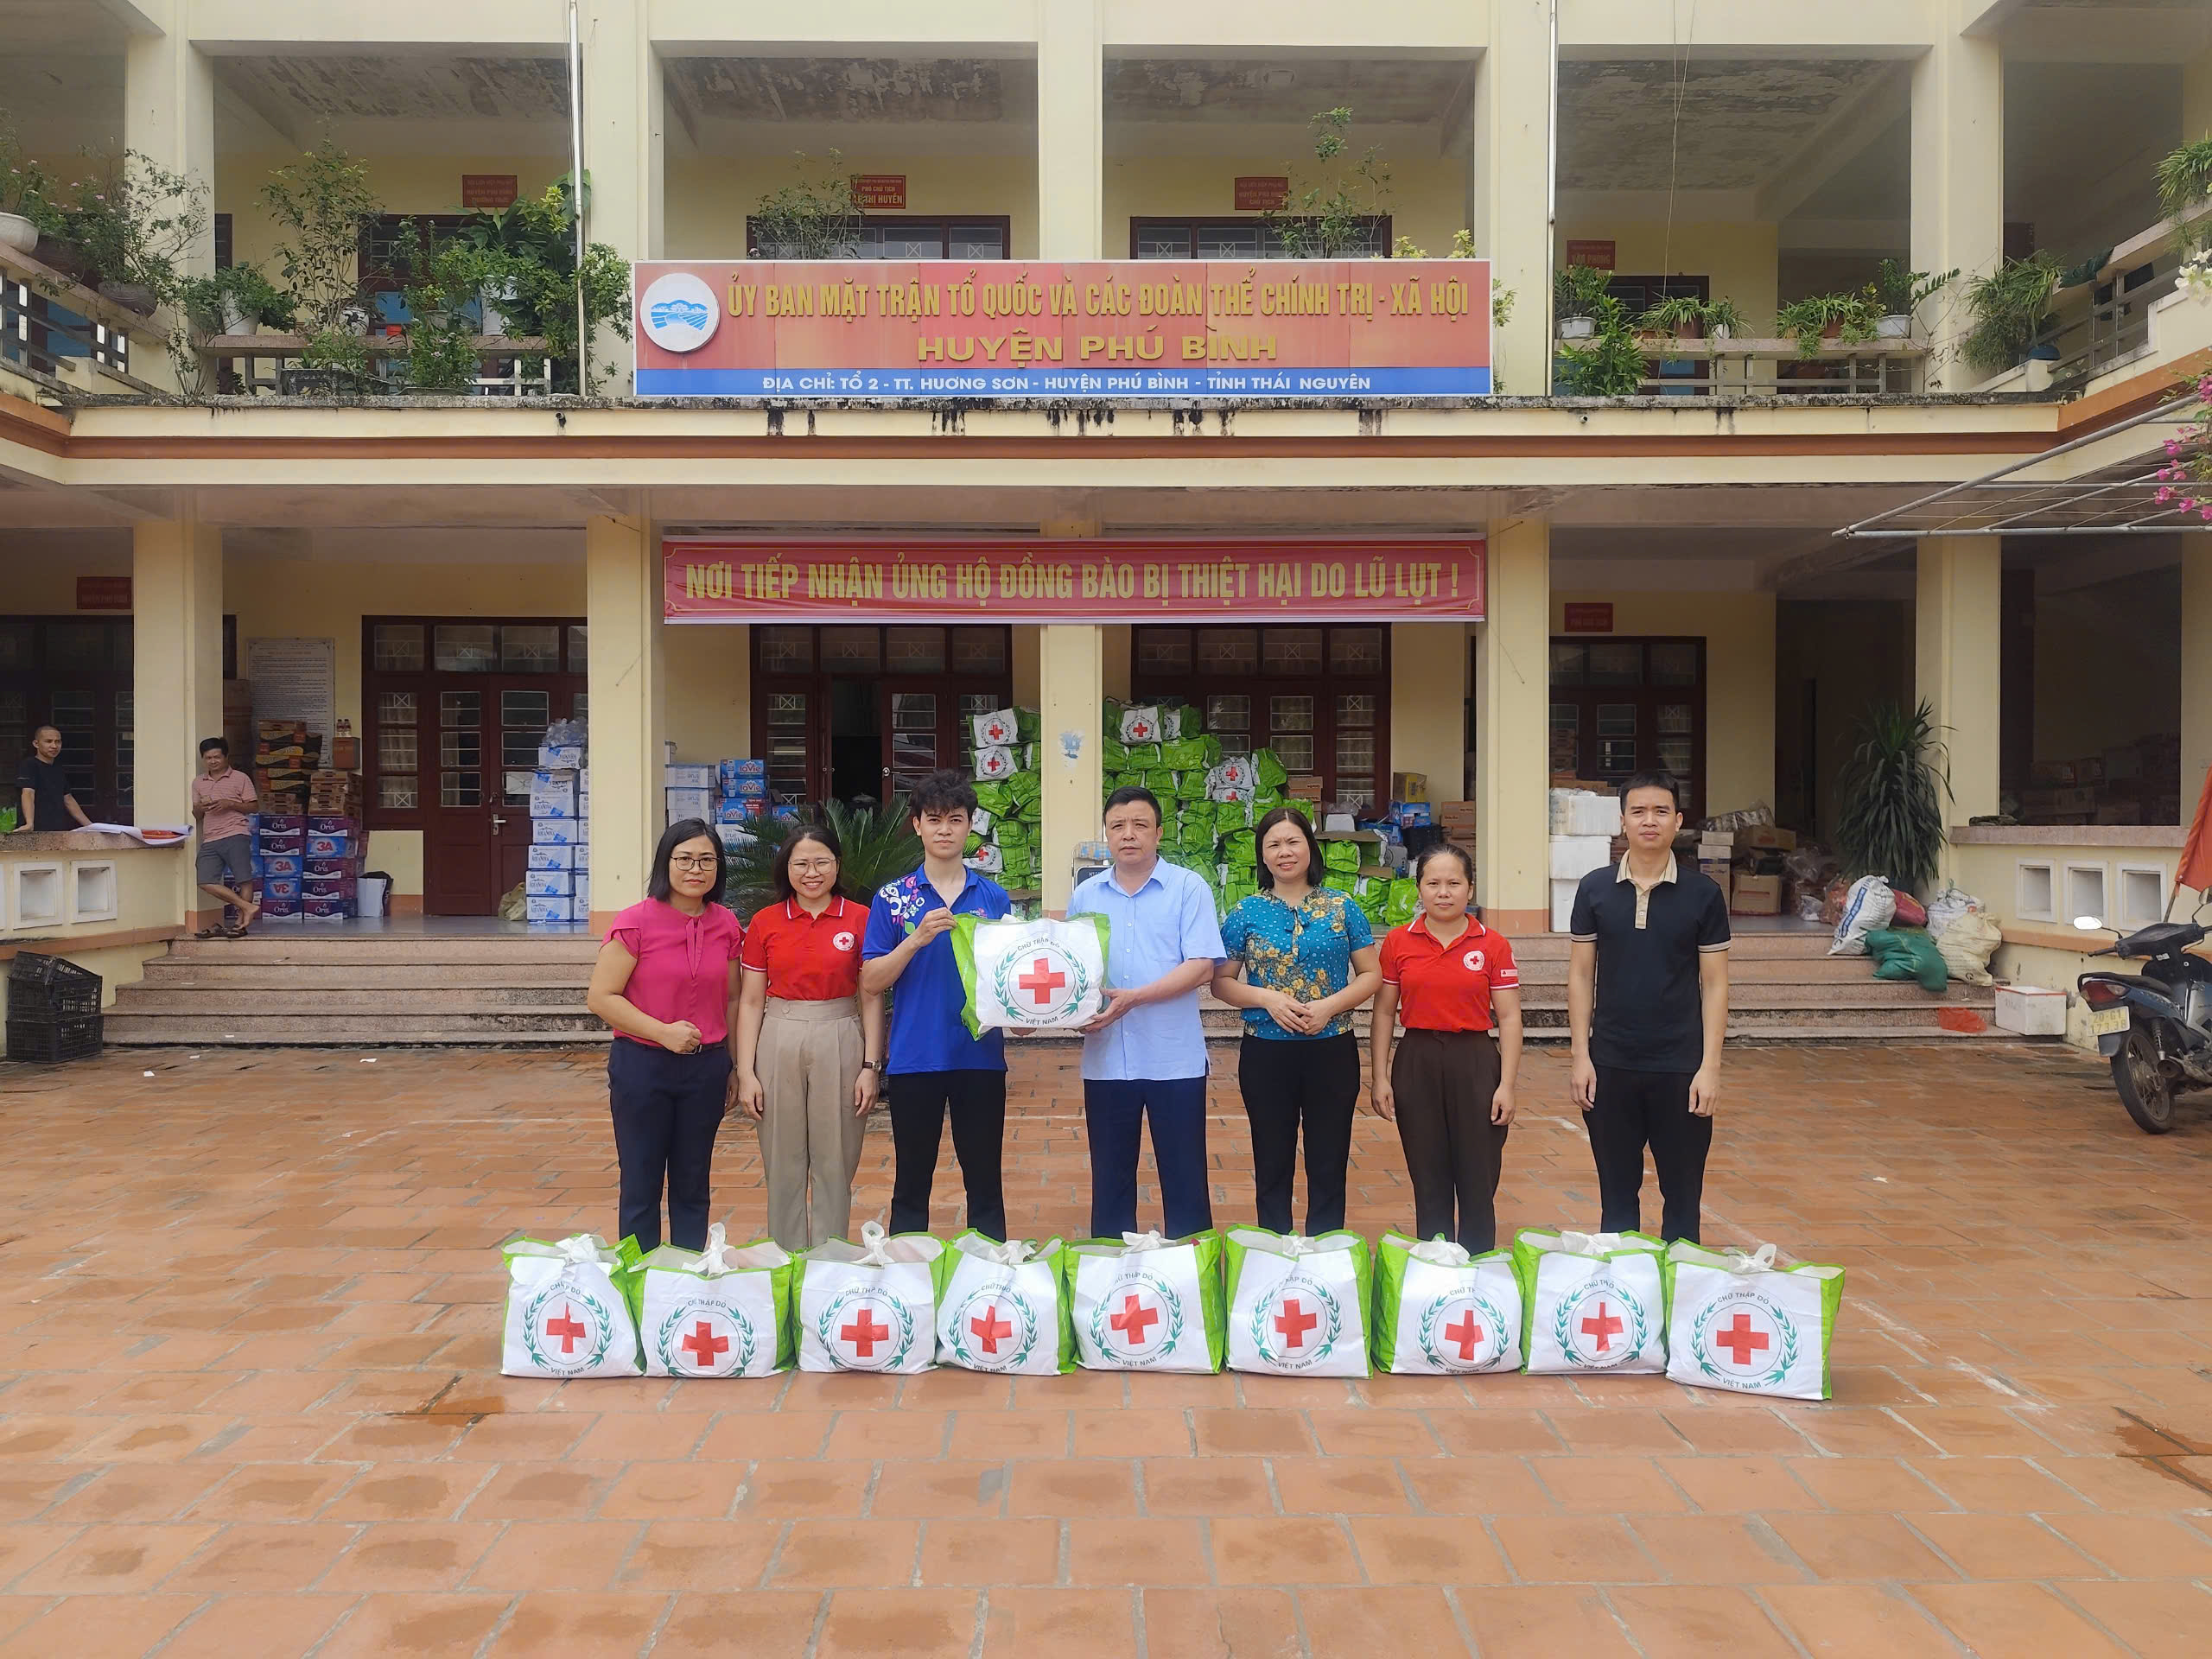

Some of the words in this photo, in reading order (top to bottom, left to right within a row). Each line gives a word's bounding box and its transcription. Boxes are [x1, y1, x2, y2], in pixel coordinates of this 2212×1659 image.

[727, 272, 757, 317] ỦY
[766, 283, 814, 317] BAN
[819, 277, 868, 323] MẶT
[876, 277, 940, 323] TRẬN
[947, 268, 977, 317] TỔ
[982, 270, 1042, 319] QUỐC
[1049, 275, 1077, 316] VÀ
[1084, 274, 1132, 316] CÁC
[1138, 275, 1204, 316] ĐOÀN
[1211, 267, 1257, 316] THỂ
[1260, 274, 1330, 316] CHÍNH
[1337, 283, 1373, 322] TRỊ
[1390, 276, 1422, 316] XÃ
[1430, 276, 1469, 322] HỘI
[918, 327, 1063, 368] HUYỆN
[1080, 325, 1165, 360] PHÚ
[1181, 325, 1277, 360] BÌNH
[762, 377, 794, 393] ĐỊA
[840, 371, 863, 390] TỔ
[868, 378, 879, 391] 2
[893, 378, 914, 391] TT.
[991, 376, 1029, 391] SƠN
[1045, 373, 1102, 392] HUYỆN
[1108, 372, 1142, 390] PHÚ
[1147, 372, 1189, 390] BÌNH
[1207, 371, 1246, 390] TỈNH
[1251, 372, 1291, 390] THÁI
[1300, 372, 1370, 390] NGUYÊN
[686, 560, 732, 599] NƠI
[741, 552, 799, 600] TIẾP
[808, 556, 883, 607] NHẬN
[892, 551, 948, 599] ỦNG
[957, 556, 991, 607] HỘ
[999, 551, 1073, 599] ĐỒNG
[1082, 556, 1135, 599] BÀO
[1143, 563, 1170, 607] BỊ
[1178, 556, 1249, 607] THIỆT
[1258, 563, 1301, 606] HẠI
[1311, 563, 1346, 598] DO
[1355, 555, 1387, 598] LŨ
[1395, 563, 1442, 606] LỤT
[1451, 562, 1459, 597] !
[316, 841, 334, 852] 3A
[275, 861, 292, 872] 3A
[1042, 1016, 1058, 1026] NAM
[1140, 1357, 1157, 1366] NAM
[1295, 1359, 1313, 1370] NAM
[567, 1366, 585, 1376] NAM
